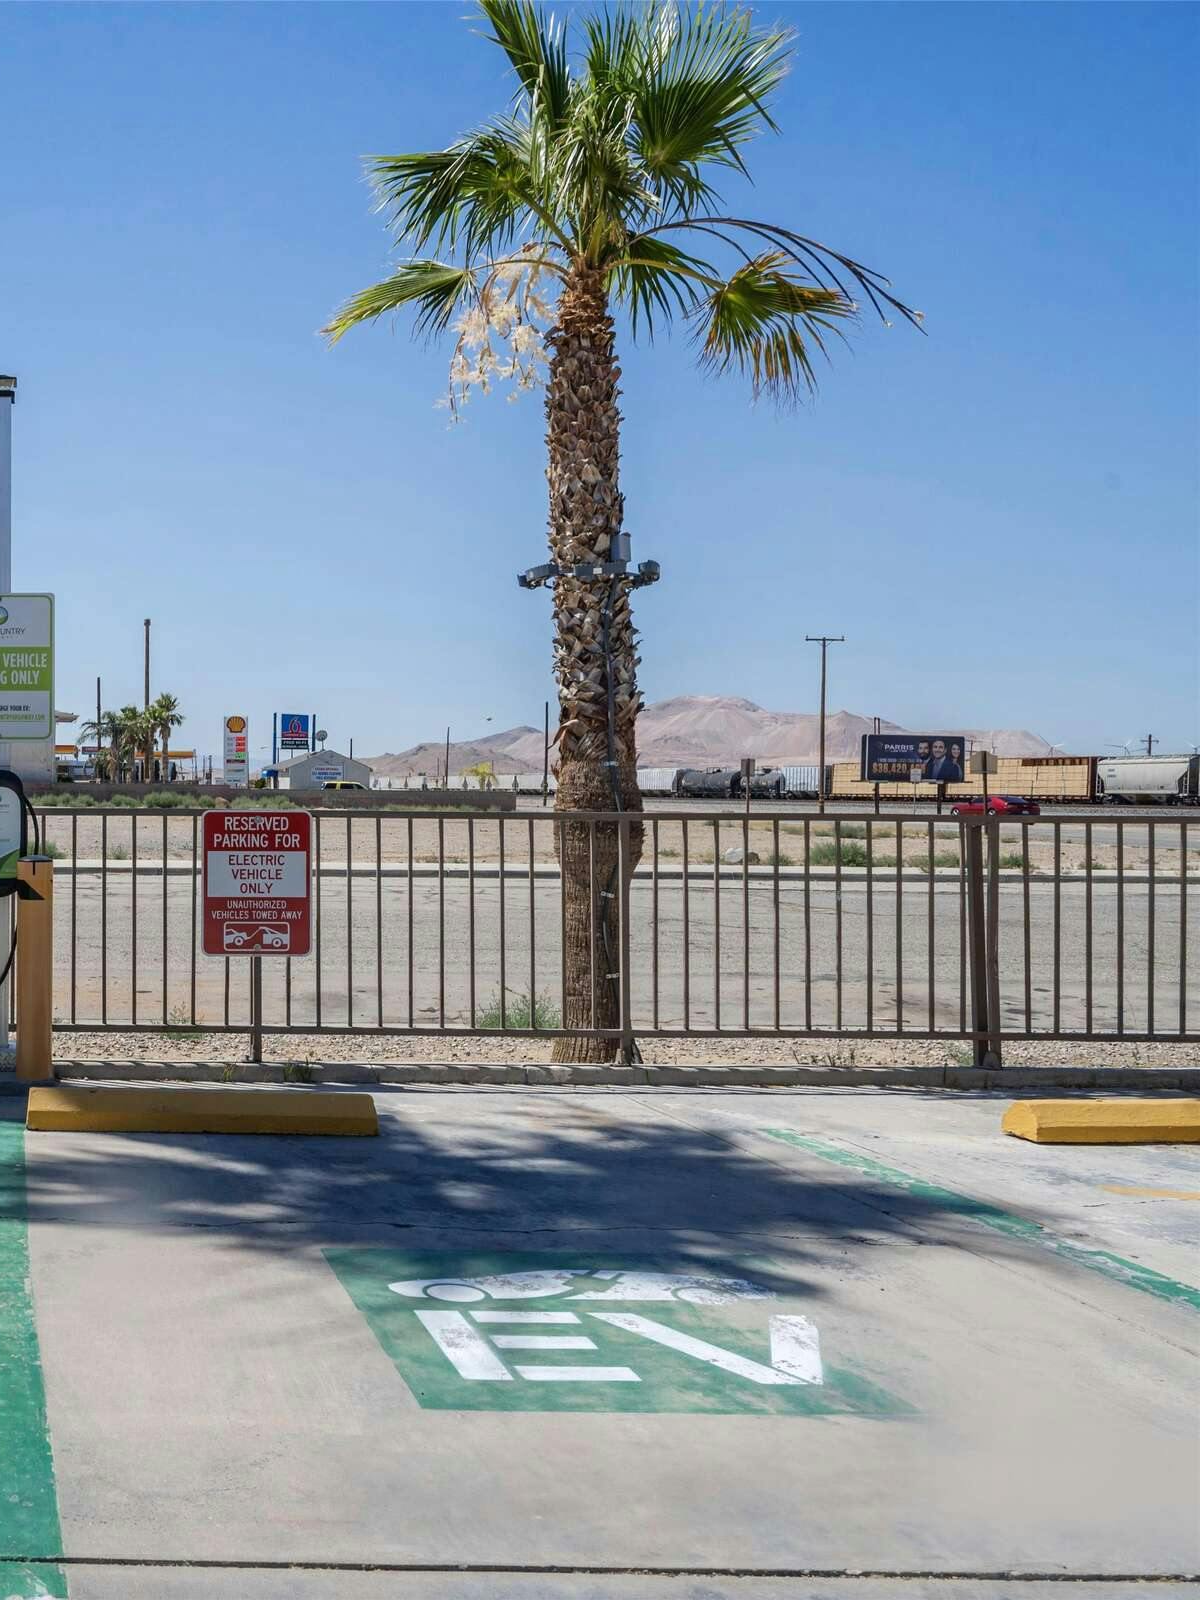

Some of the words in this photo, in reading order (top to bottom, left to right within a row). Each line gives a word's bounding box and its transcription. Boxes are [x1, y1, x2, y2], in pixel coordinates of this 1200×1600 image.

[3, 653, 48, 668] VEHICLE
[11, 670, 40, 685] ONLY
[224, 816, 289, 831] RESERVED
[213, 833, 269, 848] PARKING
[275, 833, 300, 848] FOR
[228, 854, 285, 866] ELECTRIC
[231, 869, 283, 880] VEHICLE
[239, 883, 273, 894] ONLY
[227, 900, 287, 909] UNAUTHORIZED
[211, 911, 249, 920] VEHICLES
[252, 911, 277, 920] TOWED
[281, 911, 303, 920] AWAY
[413, 1309, 824, 1385] EV
